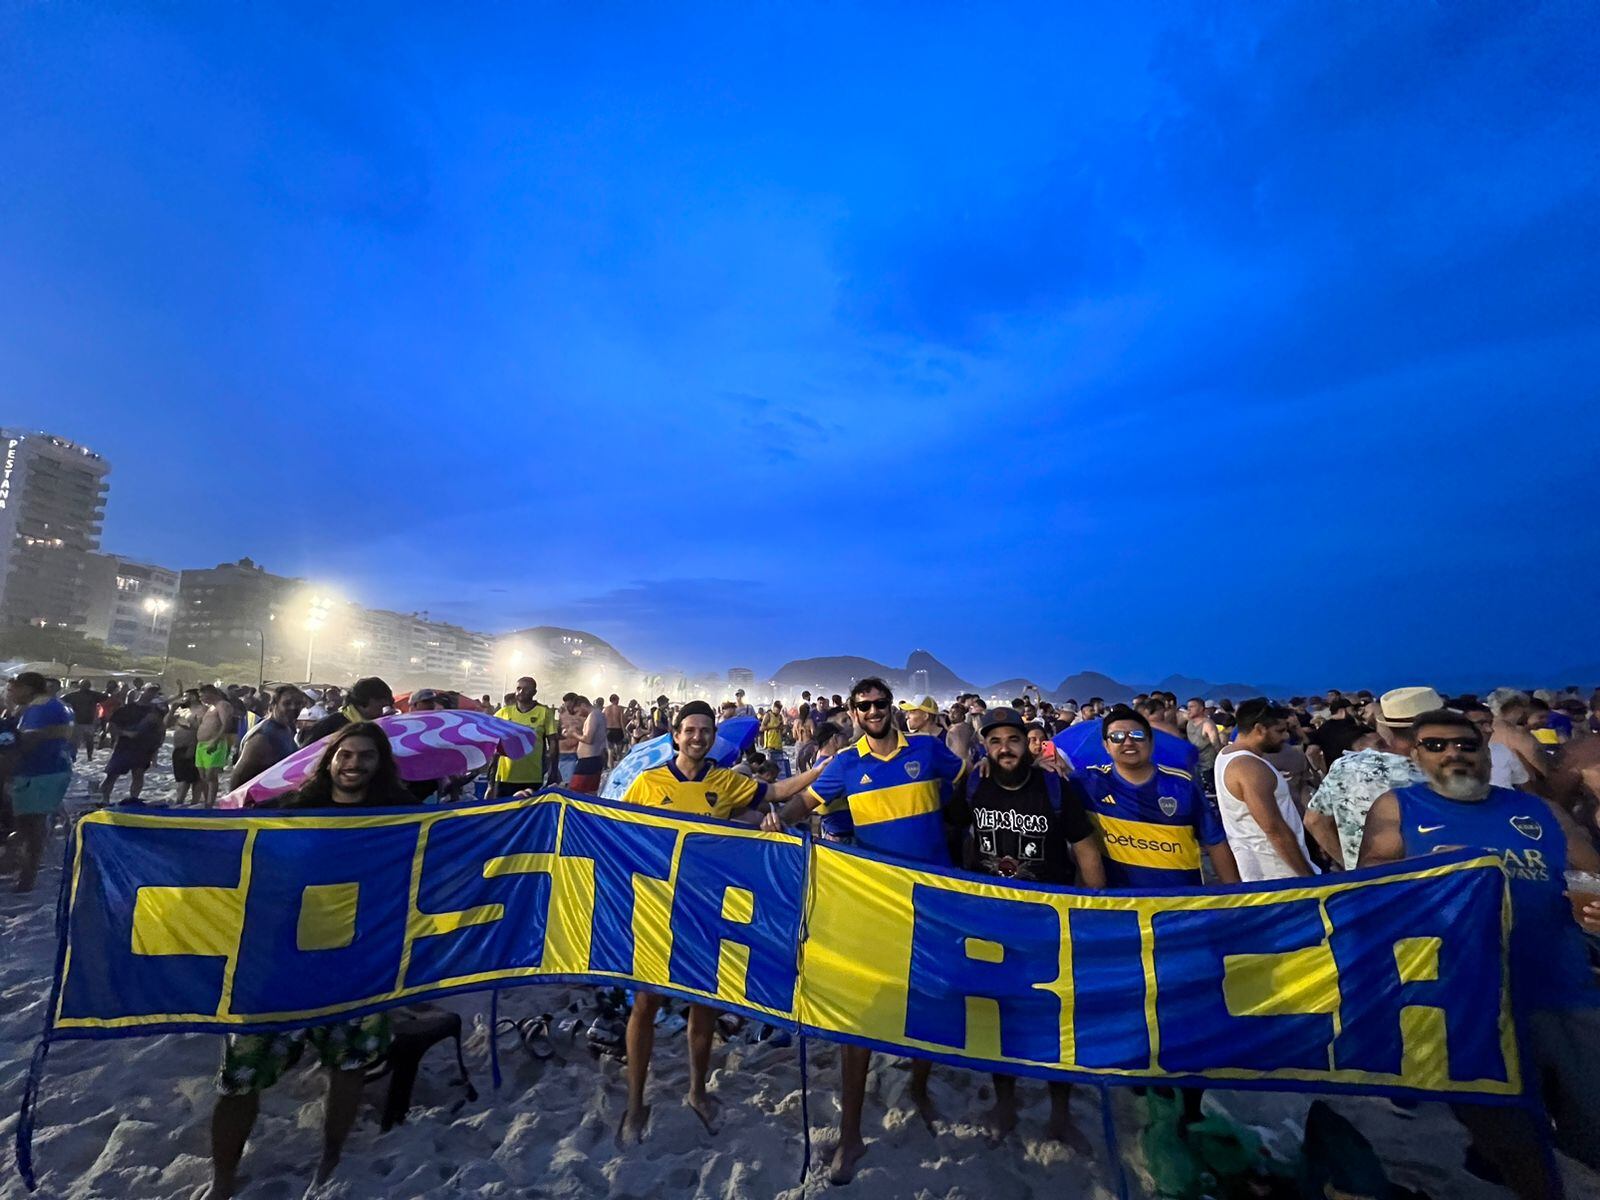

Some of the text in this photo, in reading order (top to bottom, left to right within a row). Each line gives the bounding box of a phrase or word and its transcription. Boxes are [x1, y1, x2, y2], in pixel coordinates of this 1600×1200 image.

[0, 439, 18, 509] PESTANA
[1104, 829, 1183, 854] betsson
[61, 803, 1508, 1082] COSTA RICA
